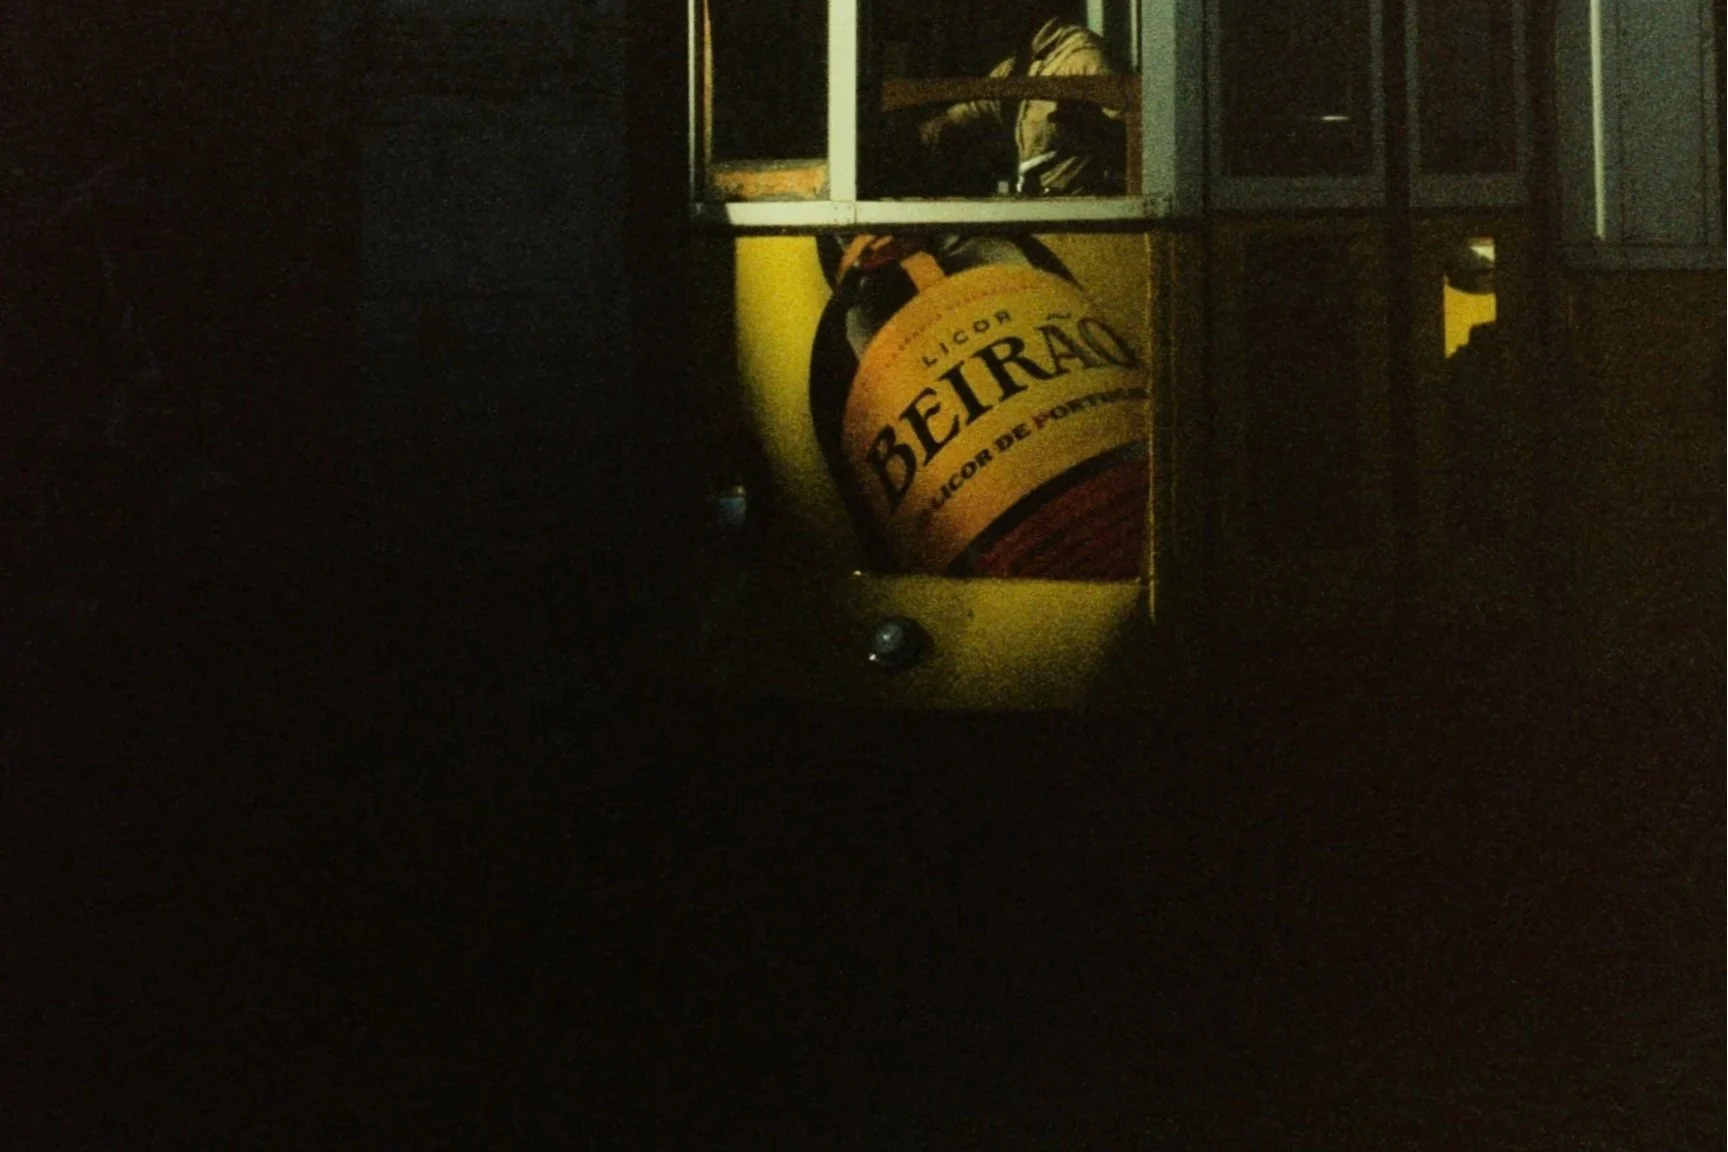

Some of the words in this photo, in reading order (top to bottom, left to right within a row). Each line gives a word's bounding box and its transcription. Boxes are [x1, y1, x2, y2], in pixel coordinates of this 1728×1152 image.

[921, 310, 1012, 367] LICOR
[866, 312, 1142, 515] BEIRÃO
[930, 449, 994, 509] LICOR
[994, 423, 1032, 454] DE
